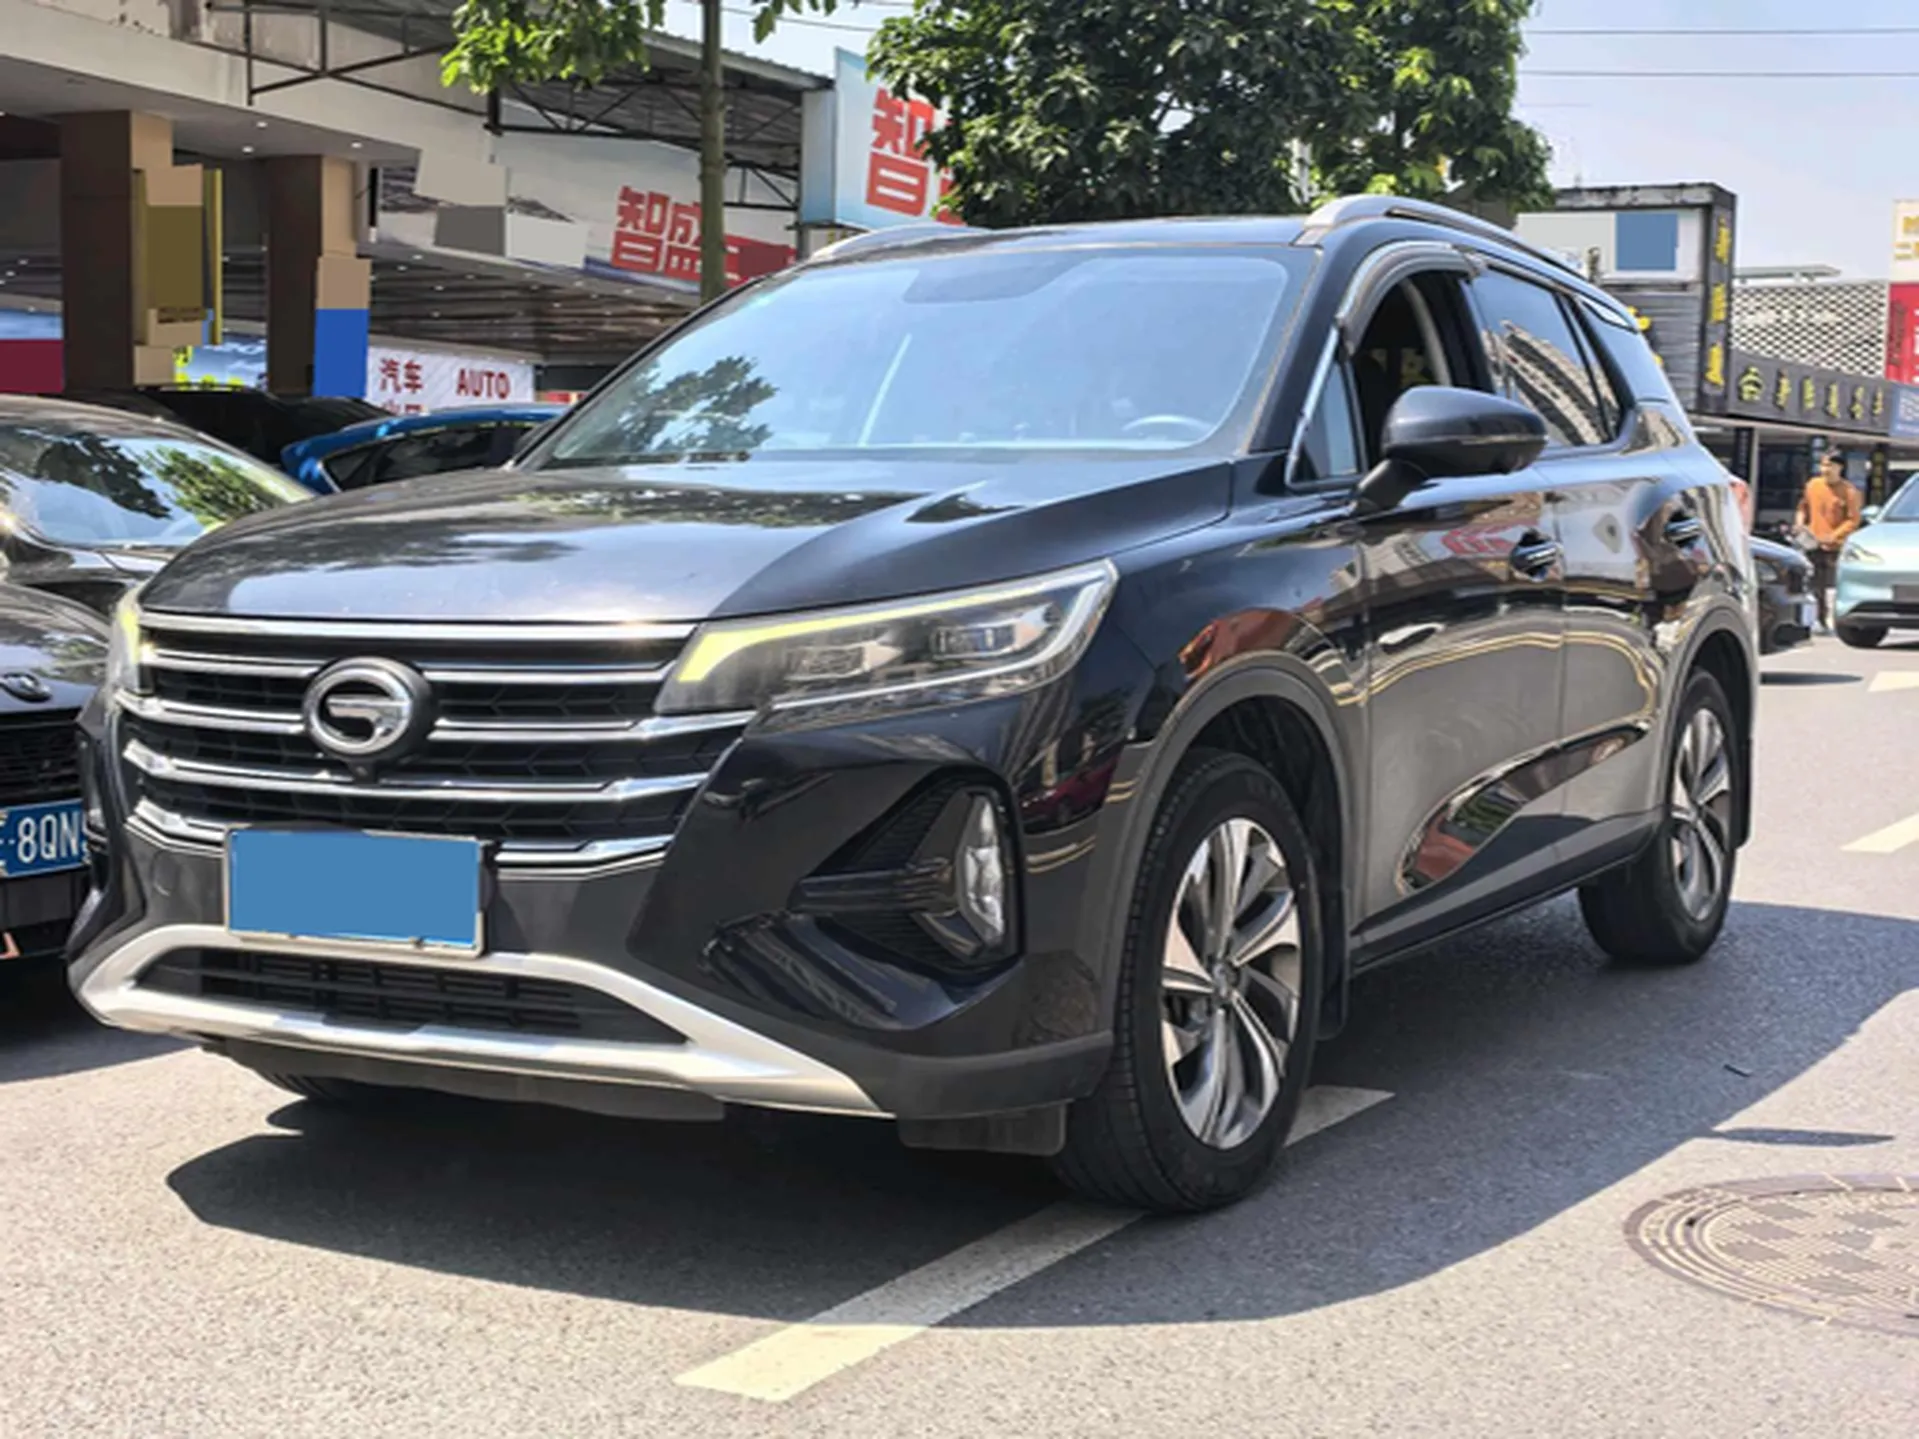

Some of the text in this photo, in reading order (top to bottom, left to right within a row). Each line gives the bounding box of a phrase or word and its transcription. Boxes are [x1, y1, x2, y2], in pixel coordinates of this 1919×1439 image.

[865, 86, 966, 225] 智
[379, 358, 423, 394] 汽车
[456, 368, 511, 399] AUTO
